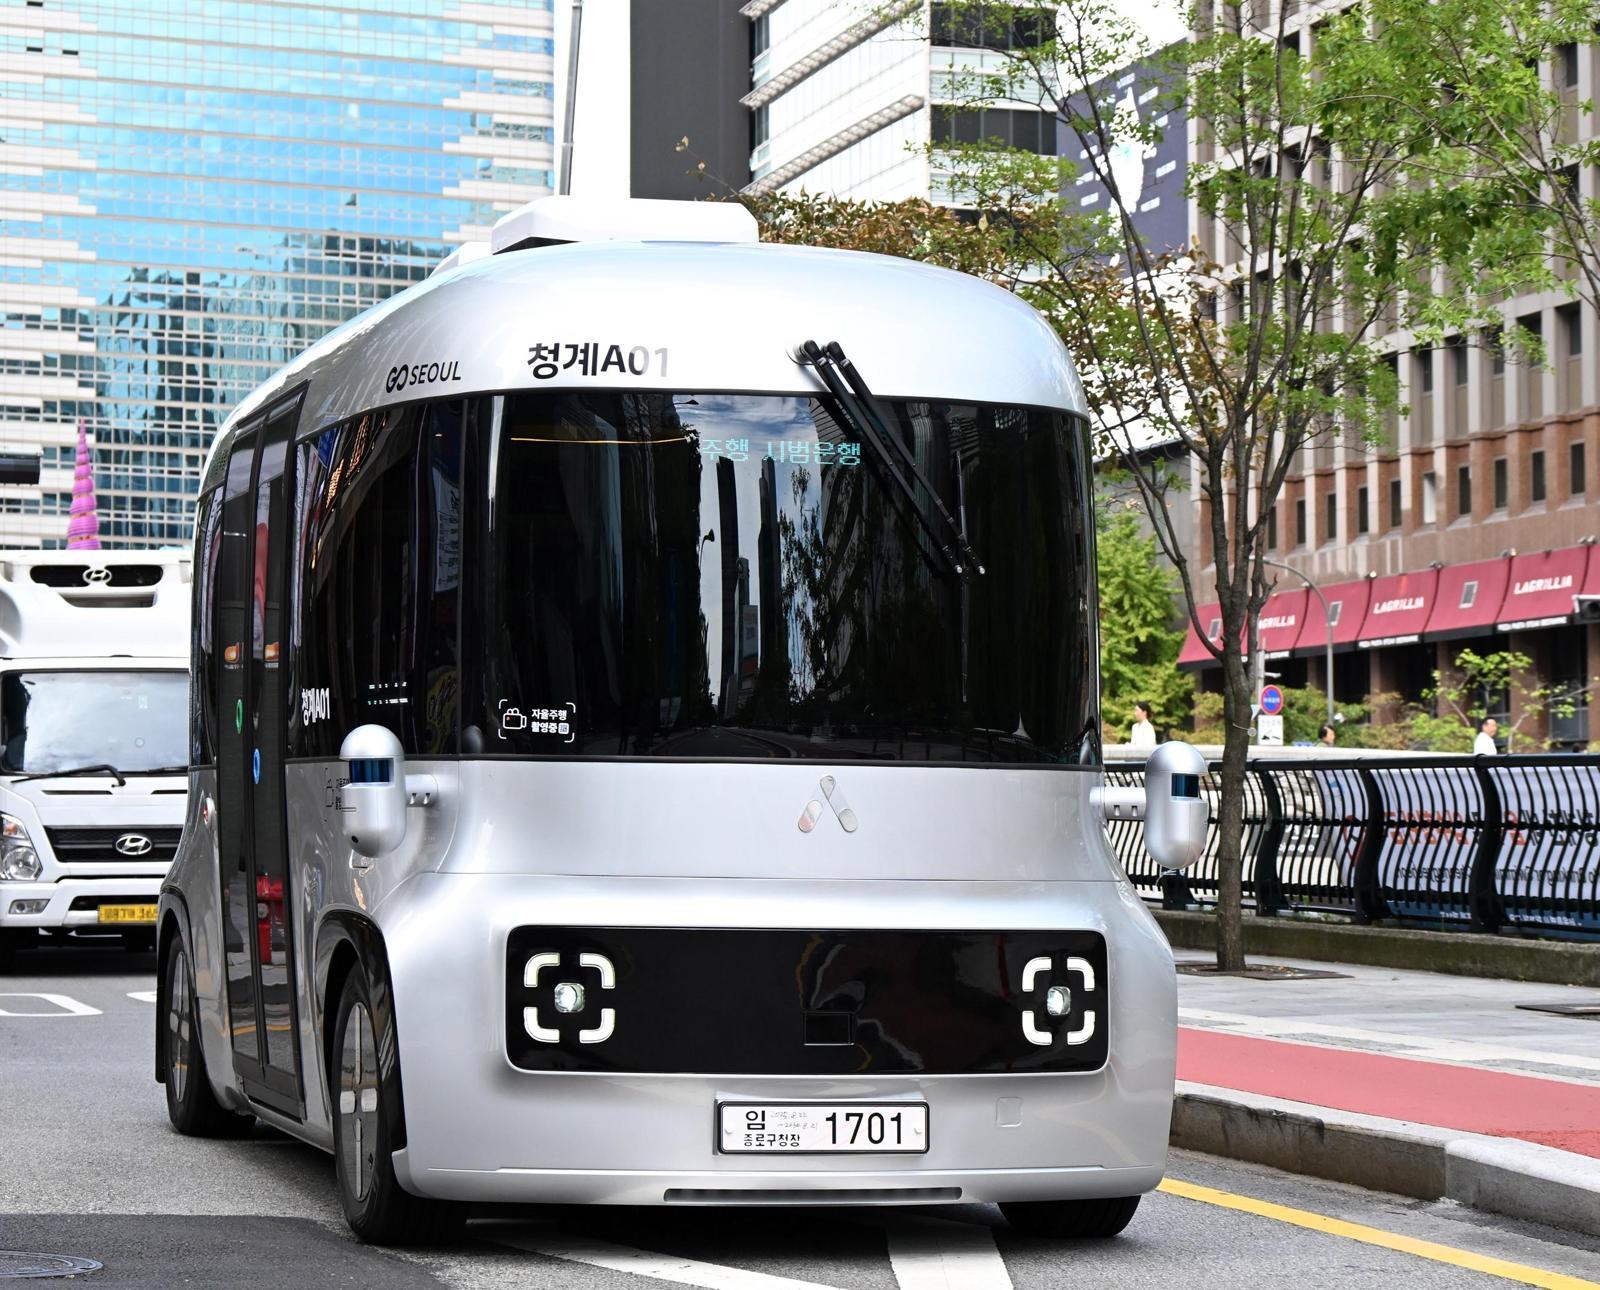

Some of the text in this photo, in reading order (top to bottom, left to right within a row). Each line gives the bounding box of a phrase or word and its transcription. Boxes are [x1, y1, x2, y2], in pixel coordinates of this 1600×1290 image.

[527, 342, 669, 380] 청계A01
[301, 687, 331, 726] 청계A01
[531, 708, 568, 721] 자율주행
[745, 1110, 766, 1131] 임
[825, 1112, 902, 1145] 1701
[744, 1134, 800, 1147] 종로구청장
